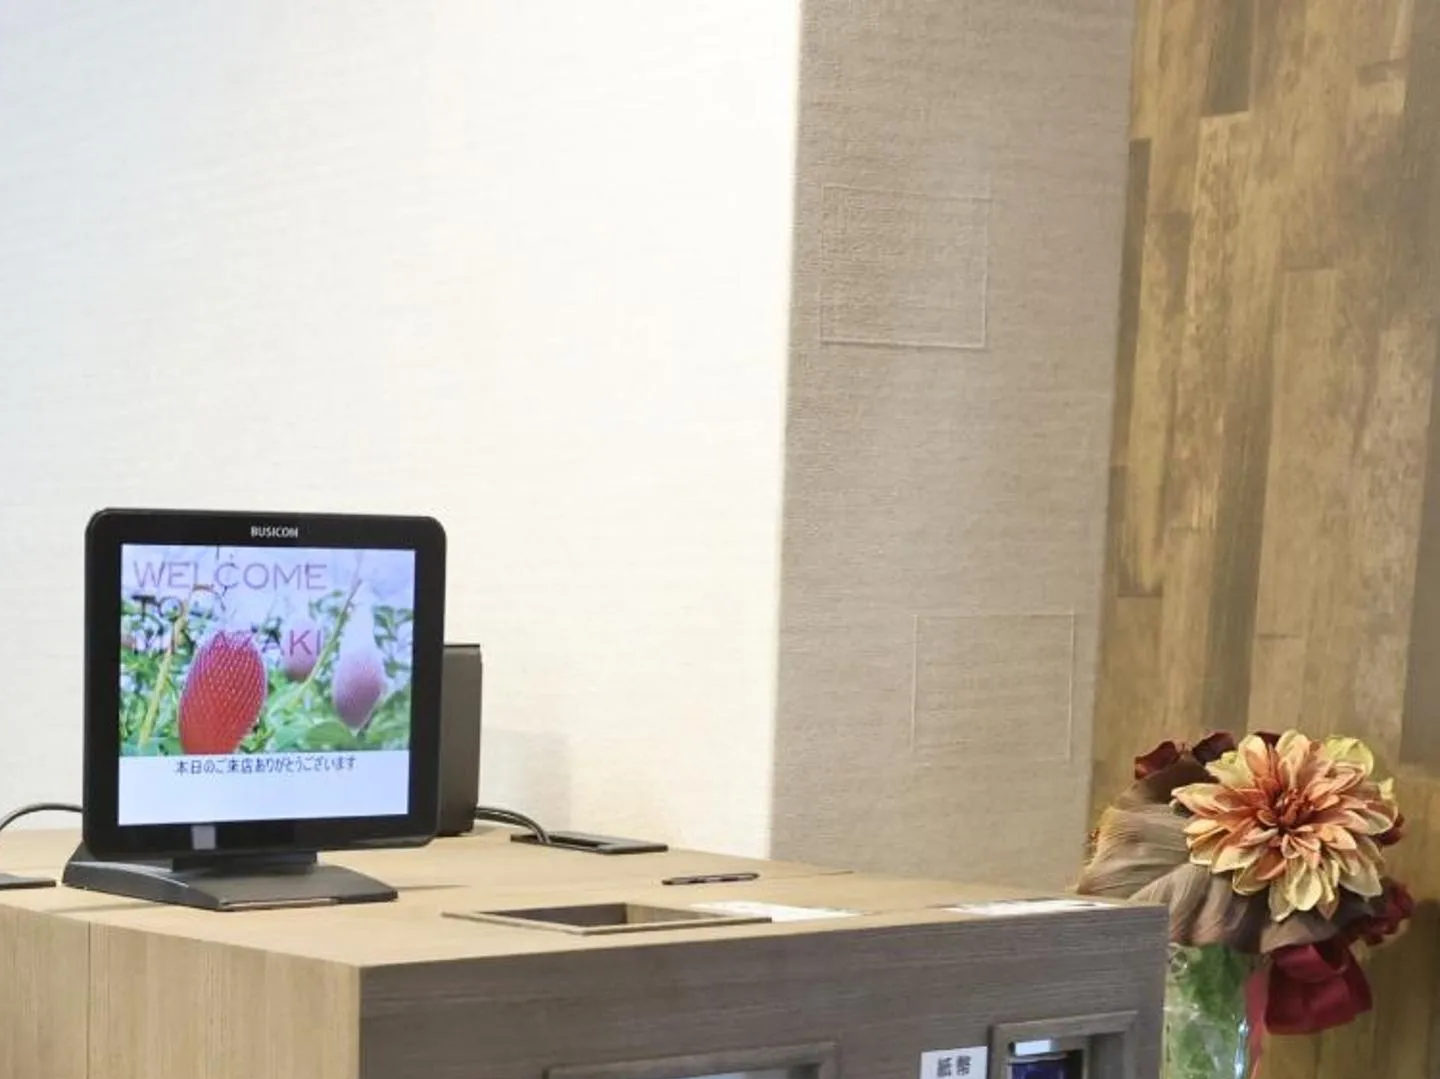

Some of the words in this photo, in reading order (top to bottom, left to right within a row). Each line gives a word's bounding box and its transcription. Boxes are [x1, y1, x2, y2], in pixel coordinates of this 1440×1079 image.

[133, 560, 328, 591] WELCOME
[175, 755, 357, 776] 本日のご来店ありがとうございます
